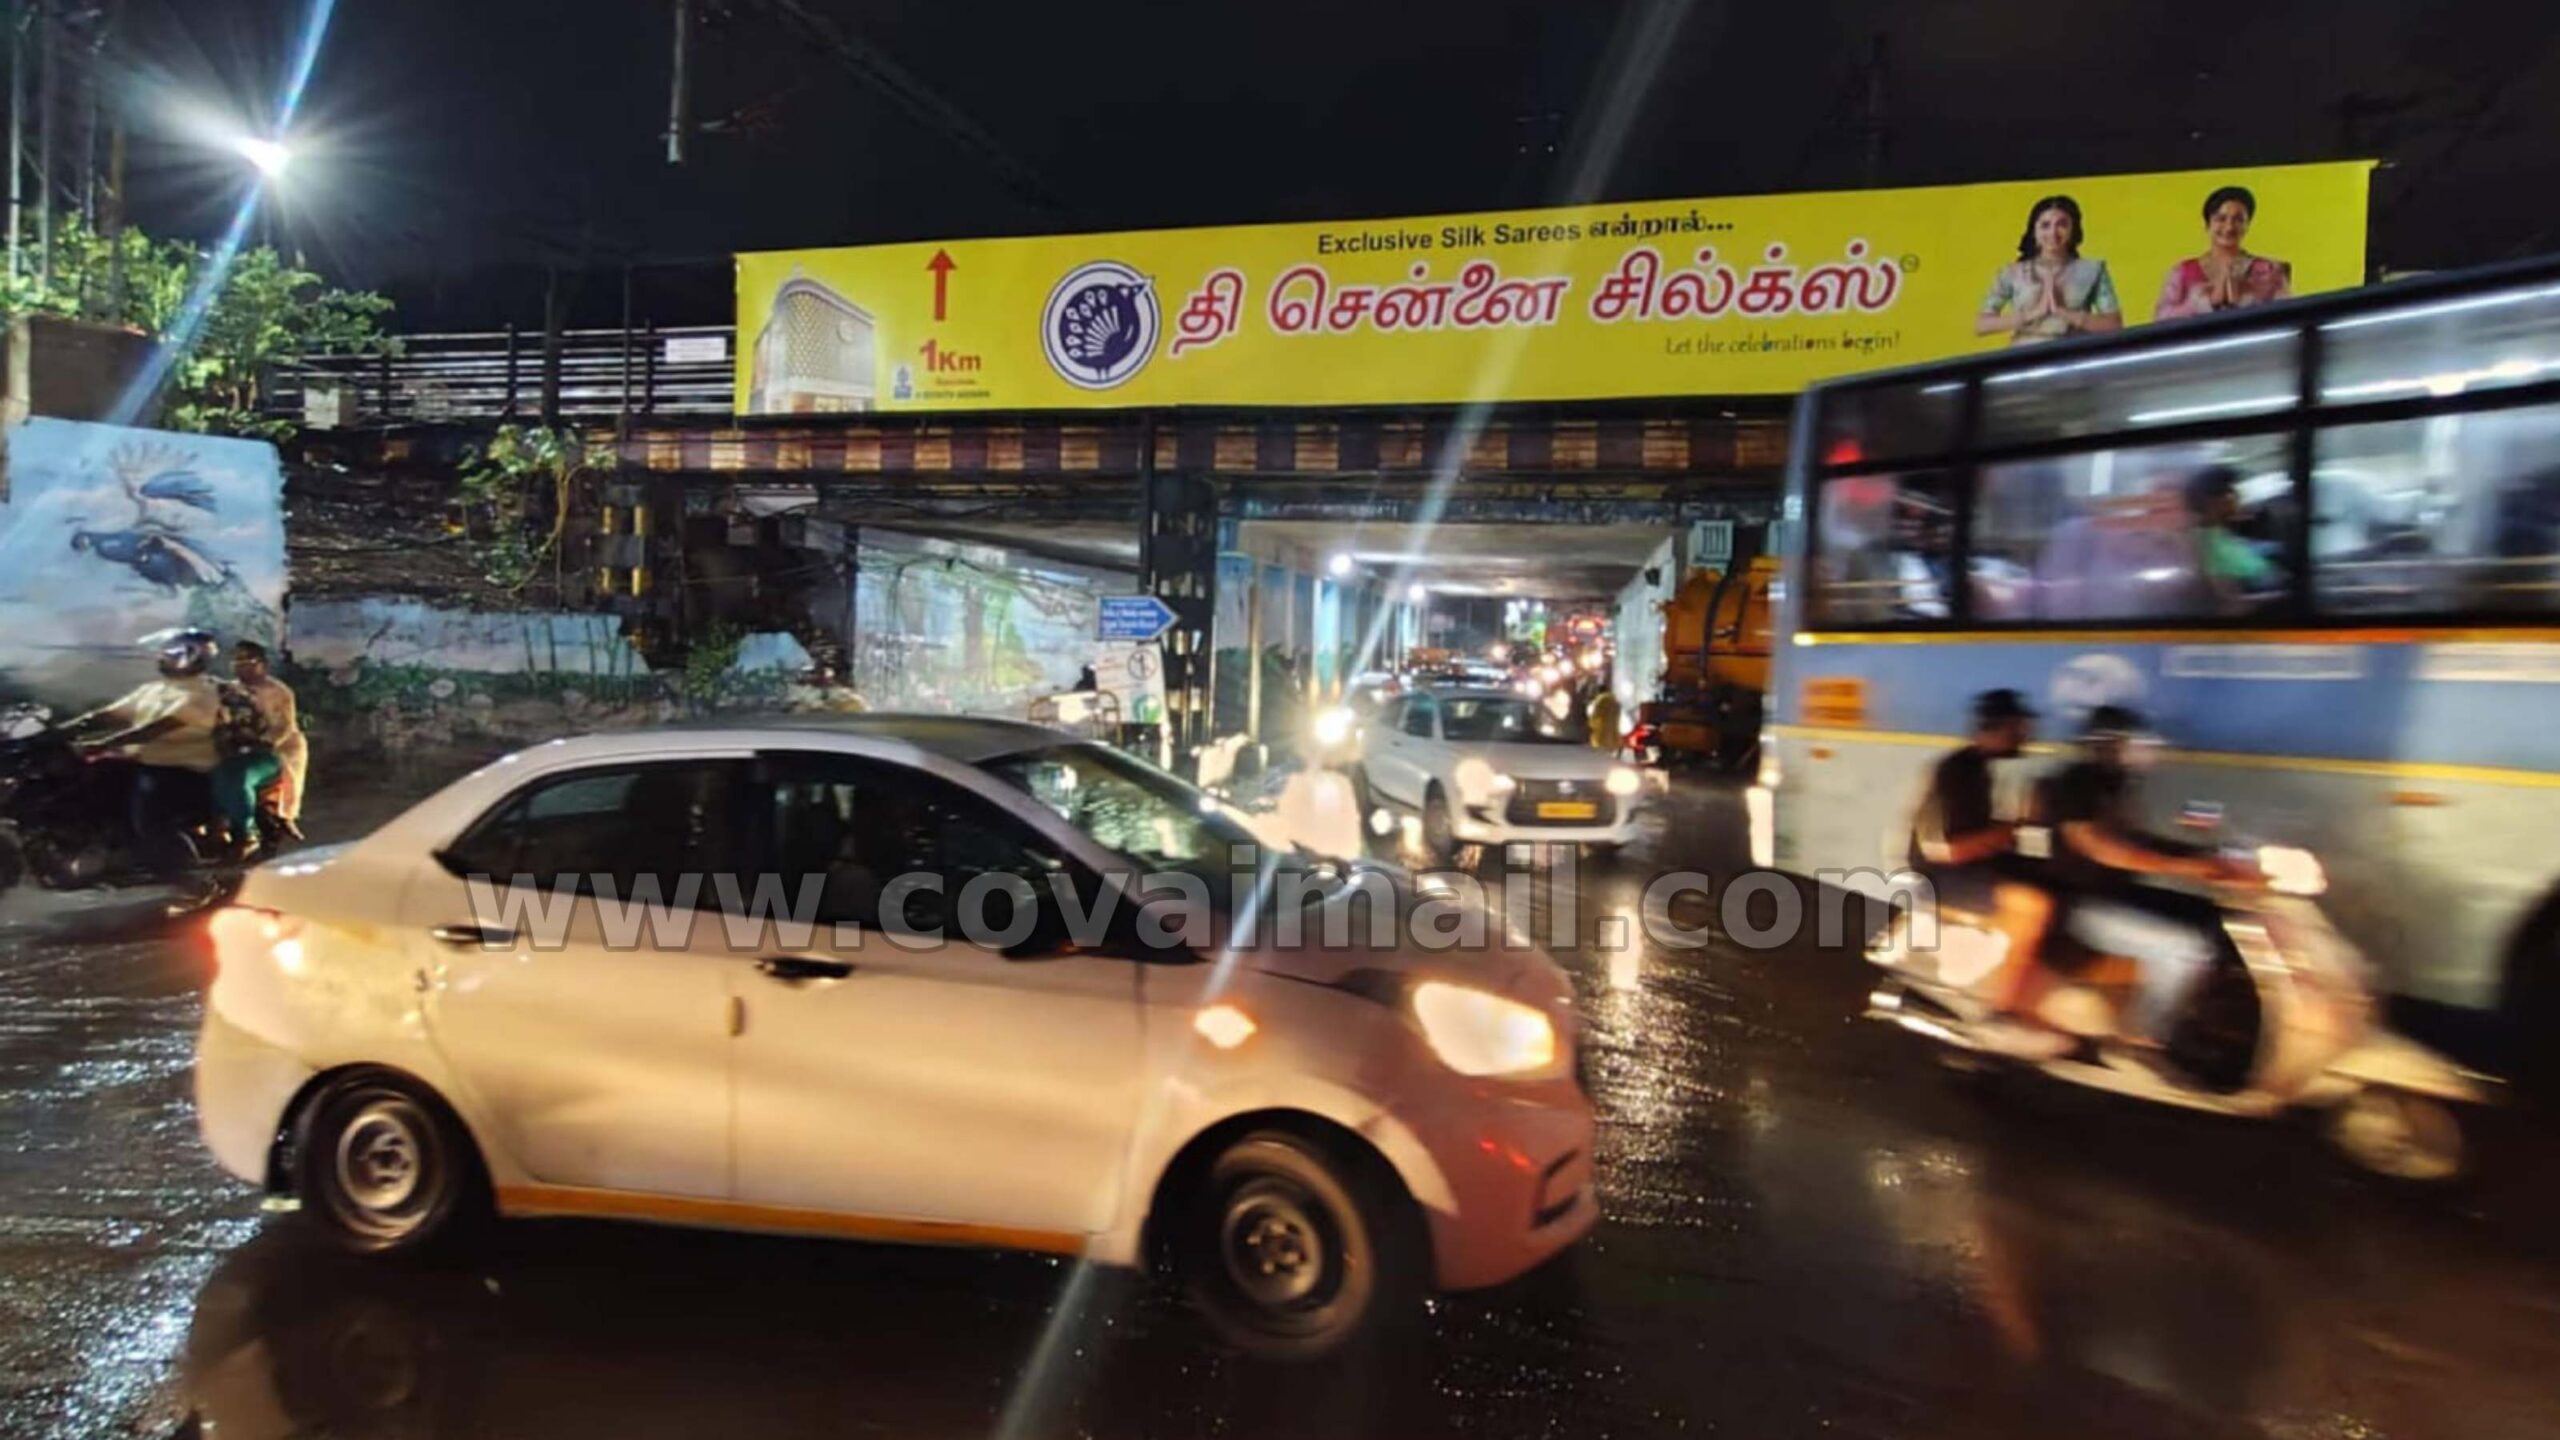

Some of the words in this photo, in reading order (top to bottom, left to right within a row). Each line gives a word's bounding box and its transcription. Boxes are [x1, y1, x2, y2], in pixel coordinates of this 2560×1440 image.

[1318, 229, 1433, 255] Exclusive
[1441, 223, 1486, 249] Silk
[1494, 220, 1581, 246] Sarees
[1589, 210, 1735, 241] என்றால்...
[1171, 270, 1245, 356] தி
[1268, 261, 1567, 334] சென்னை
[1591, 242, 1899, 321] சில்க்ஸ்
[1666, 336, 1693, 355] Let
[1697, 333, 1725, 353] the
[1728, 331, 1837, 353] celebrations
[1842, 330, 1901, 356] begin!
